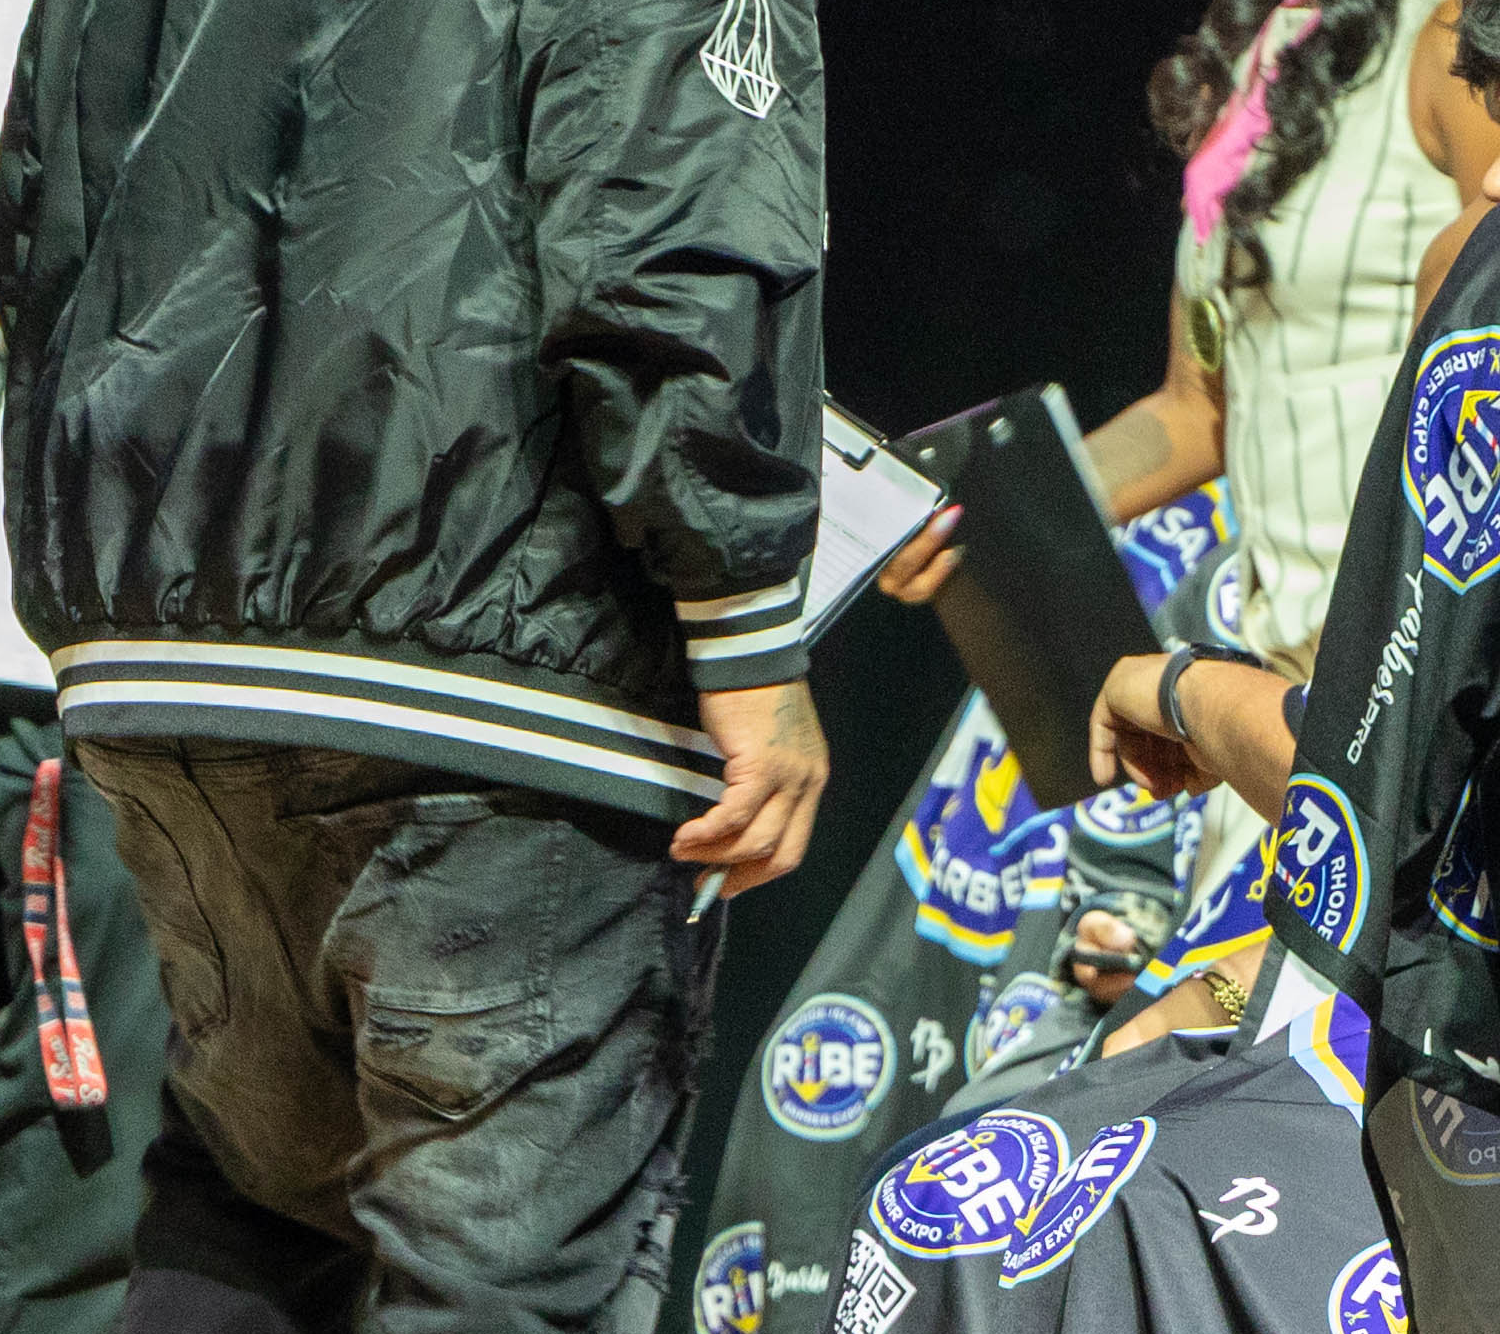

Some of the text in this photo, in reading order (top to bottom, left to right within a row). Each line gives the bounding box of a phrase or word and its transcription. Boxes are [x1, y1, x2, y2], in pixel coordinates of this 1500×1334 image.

[1413, 396, 1431, 464] EXPO
[1027, 1132, 1050, 1192] ISLAND
[900, 1219, 943, 1243] EXPO
[1044, 1204, 1085, 1252] EXPO
